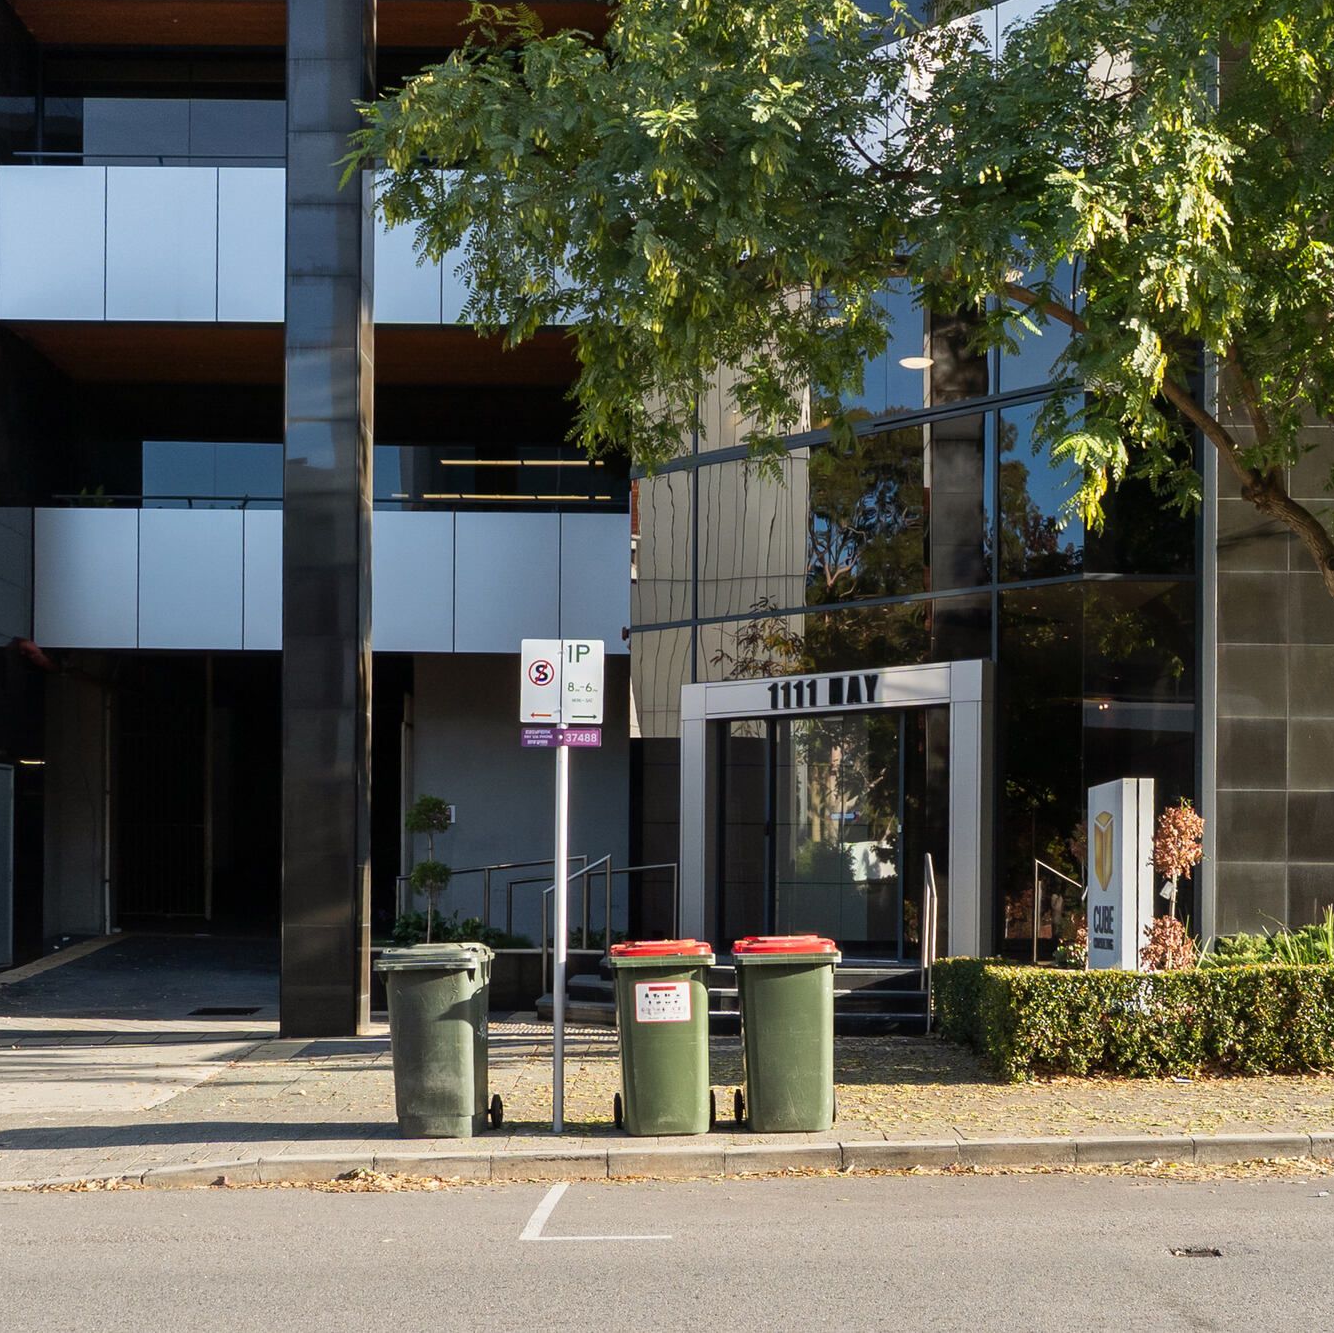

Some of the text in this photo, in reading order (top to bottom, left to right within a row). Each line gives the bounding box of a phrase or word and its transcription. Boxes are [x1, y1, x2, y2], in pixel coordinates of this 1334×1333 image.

[567, 644, 591, 663] 1P
[767, 679, 818, 710] 1111
[565, 733, 597, 743] 37488
[1093, 905, 1115, 935] CUBE
